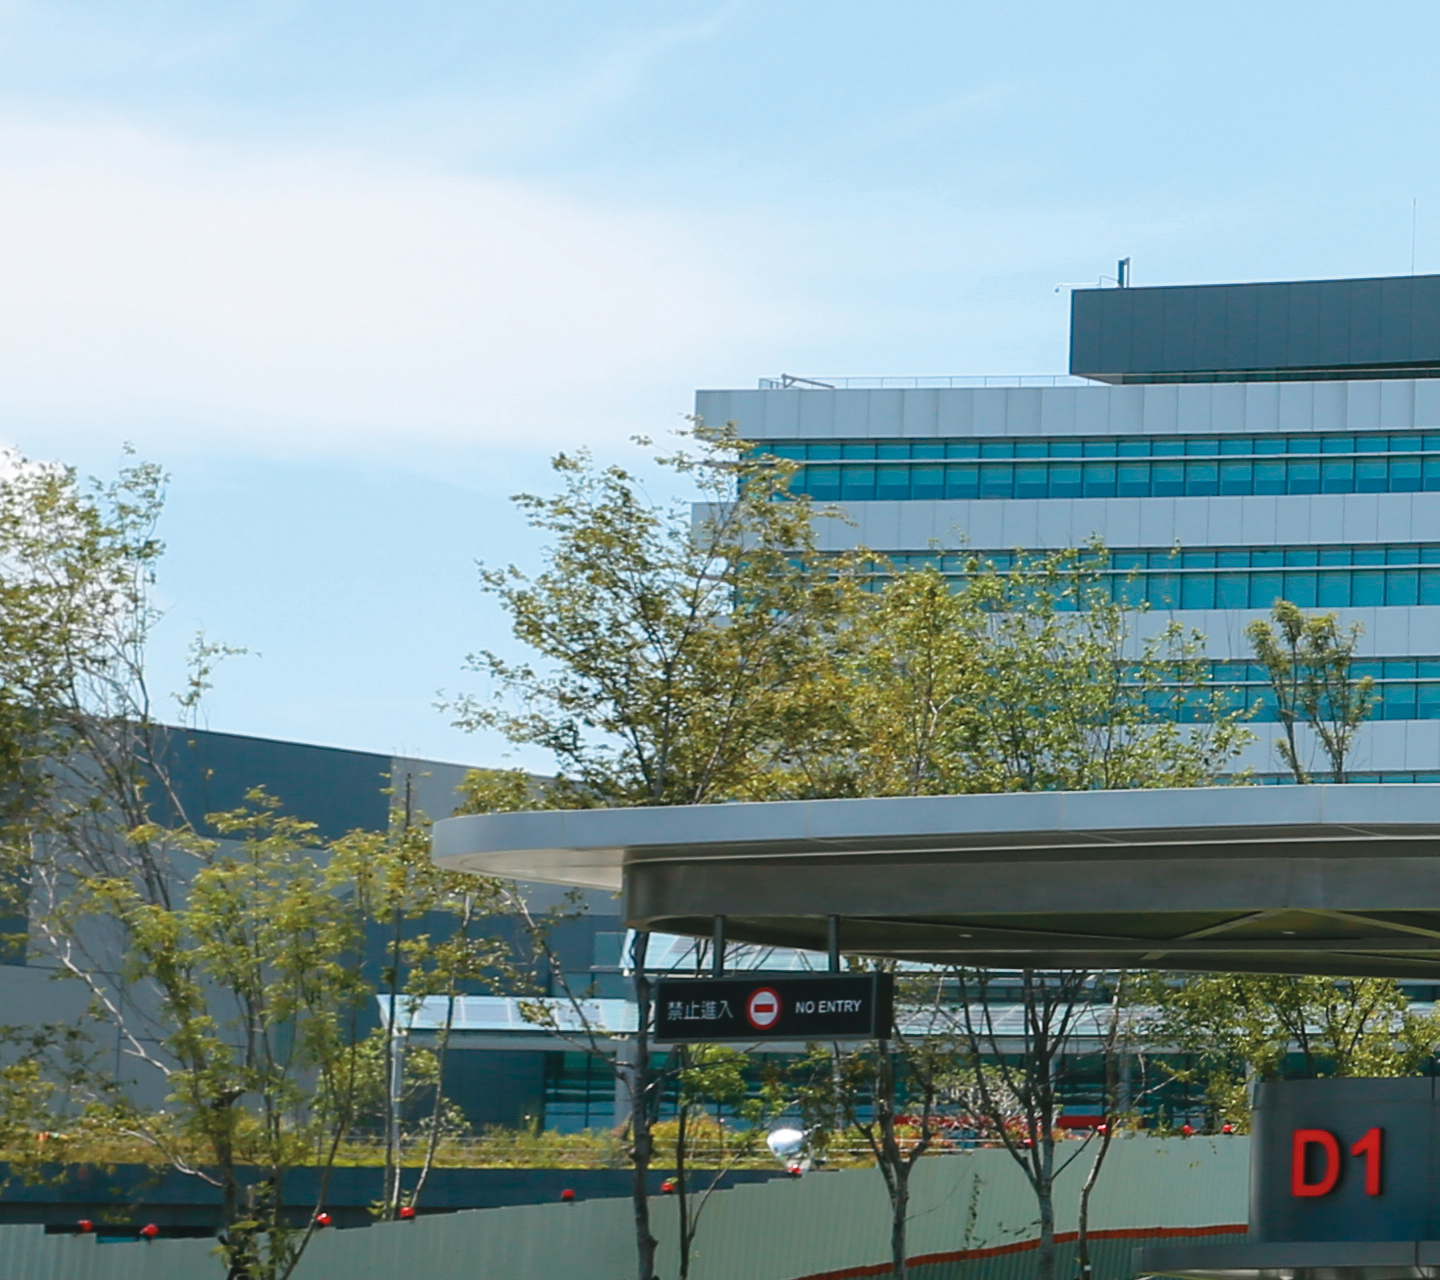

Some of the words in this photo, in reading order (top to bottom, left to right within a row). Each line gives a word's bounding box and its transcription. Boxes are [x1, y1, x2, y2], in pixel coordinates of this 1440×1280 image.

[667, 1000, 733, 1020] 禁止進入
[795, 1000, 816, 1014] NO
[818, 999, 862, 1013] ENTRY
[1291, 1126, 1382, 1197] D1
